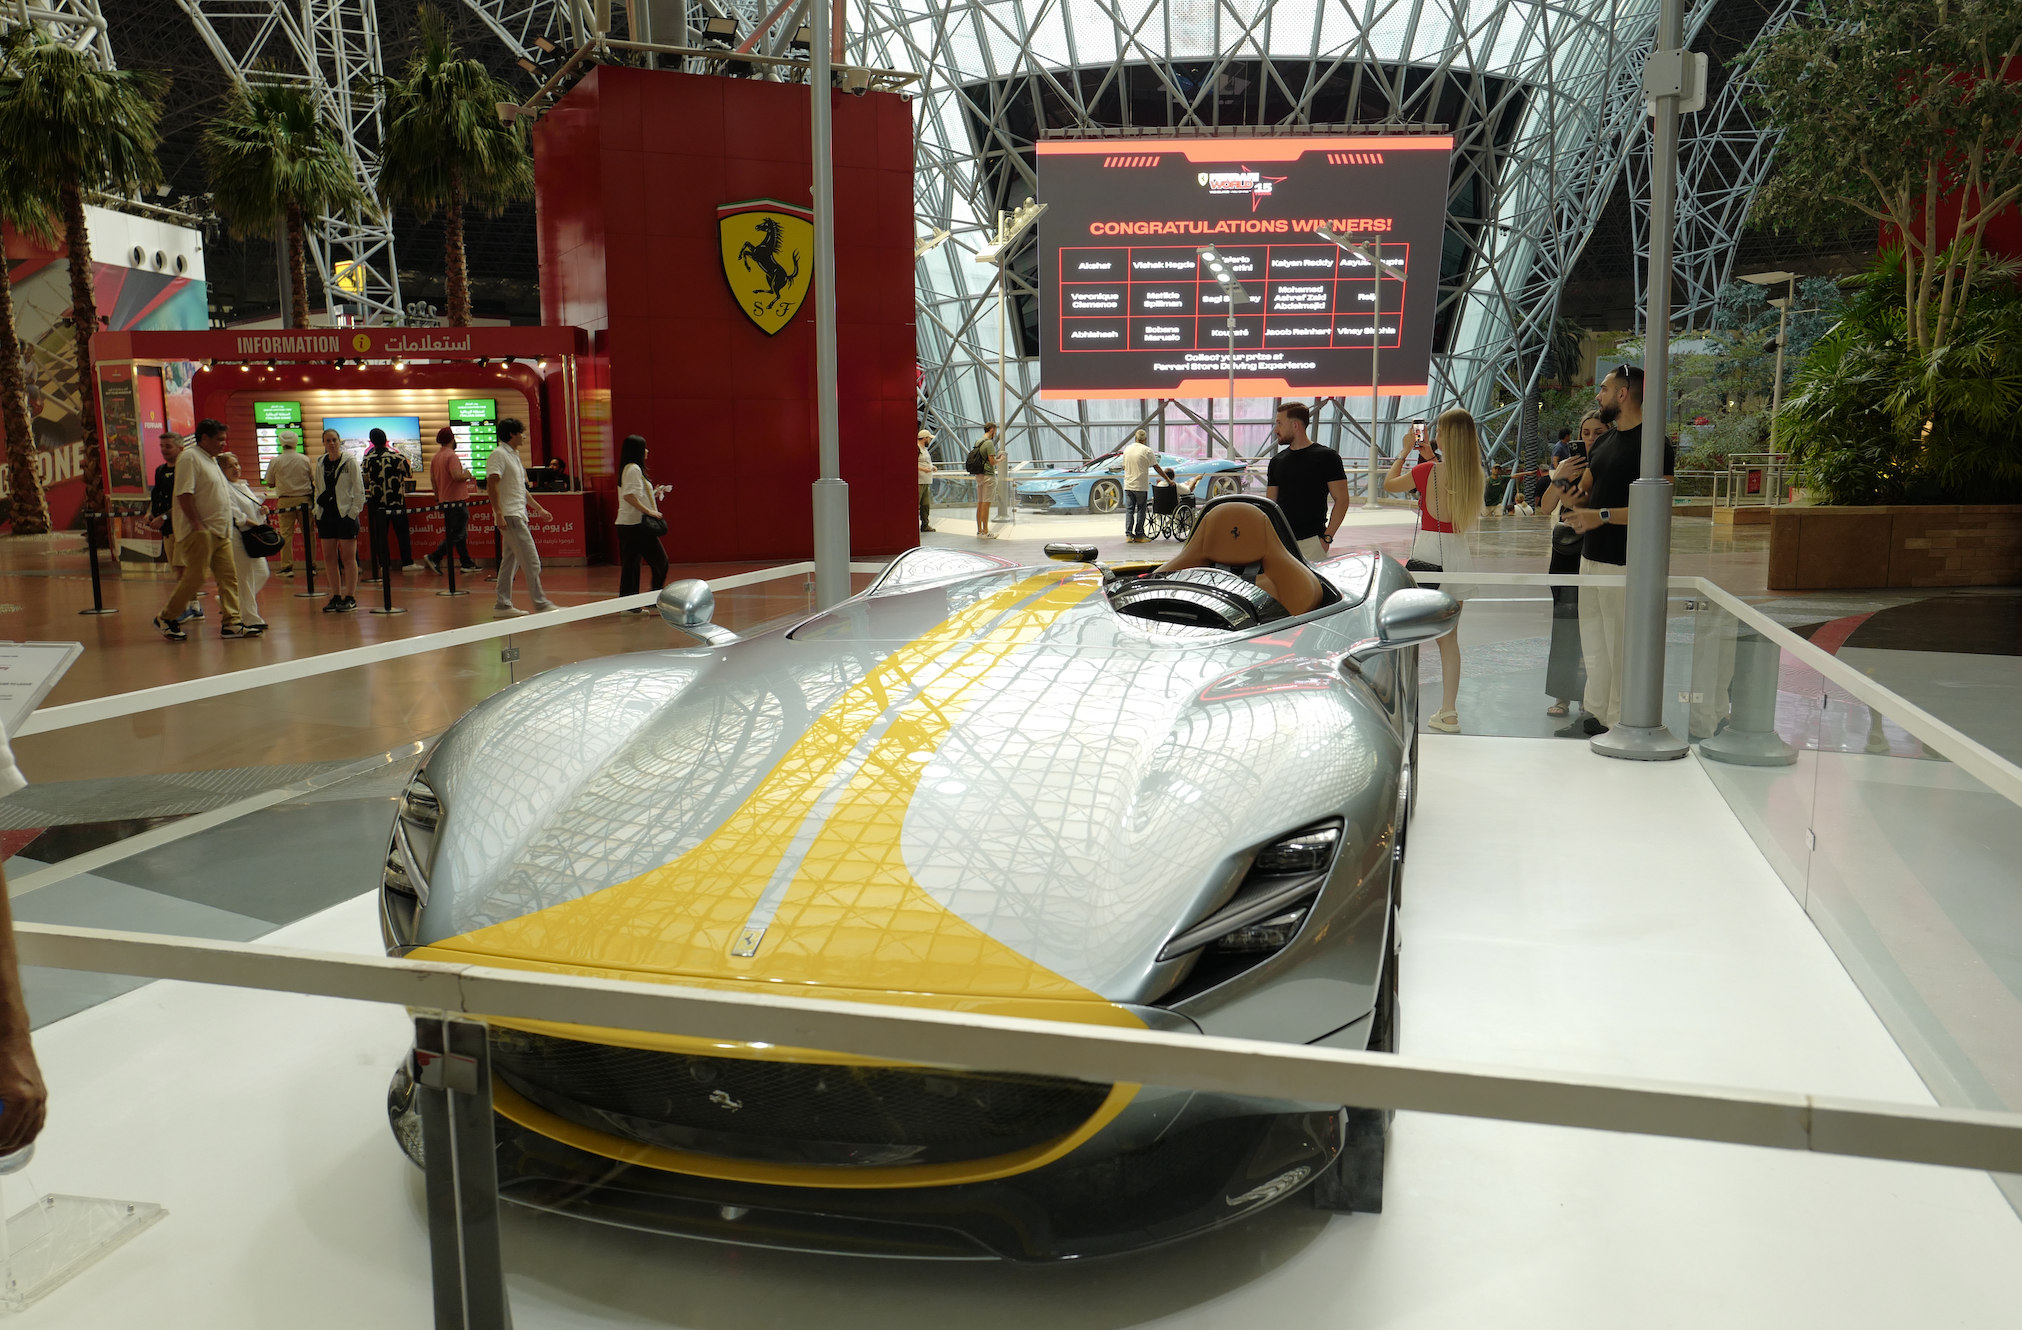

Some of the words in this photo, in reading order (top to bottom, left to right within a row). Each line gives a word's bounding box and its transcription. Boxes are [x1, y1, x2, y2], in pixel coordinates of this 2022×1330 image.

[1254, 182, 1273, 193] 15
[1089, 219, 1289, 236] CONGRATULATIONS
[1291, 218, 1393, 233] WINNERS!
[1303, 258, 1334, 268] Reddy
[1278, 285, 1324, 293] Mohamed
[1070, 292, 1119, 301] Veronique
[237, 335, 340, 354] INFORMATION
[384, 334, 471, 352] استعلامات
[1184, 353, 1220, 362] Collect
[1245, 353, 1273, 363] prize
[1273, 353, 1285, 361] at
[1153, 362, 1190, 371] Ferrari
[1190, 362, 1220, 371] Store
[1258, 361, 1317, 371] Experience
[144, 421, 163, 429] FERRARI
